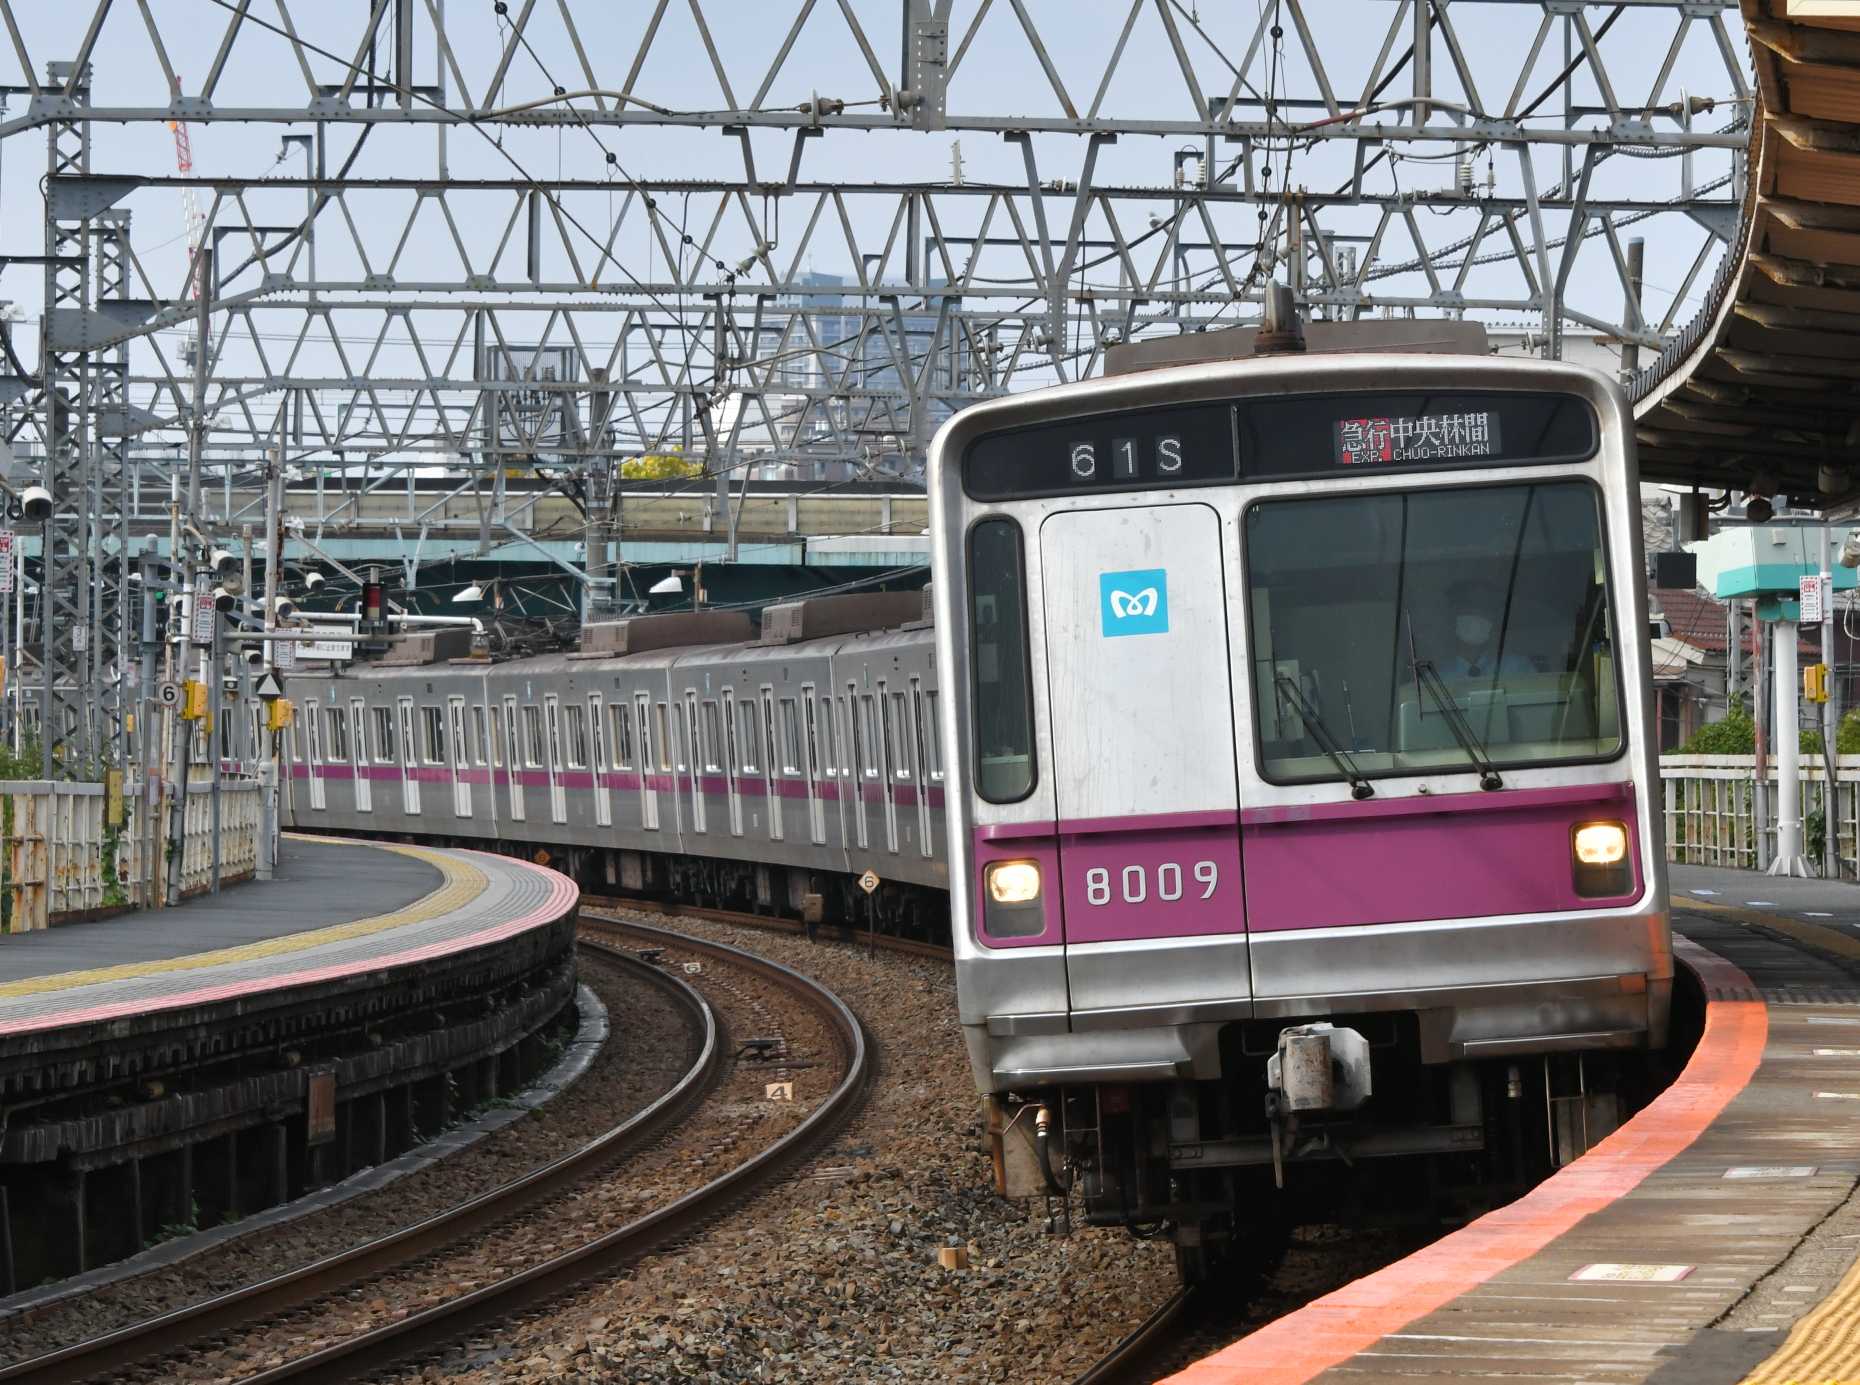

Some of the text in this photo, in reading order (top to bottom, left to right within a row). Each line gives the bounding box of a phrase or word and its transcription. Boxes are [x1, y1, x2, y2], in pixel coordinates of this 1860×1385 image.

[1351, 442, 1490, 464] EXP. CHUO-RINKAN
[163, 686, 175, 701] 6
[864, 876, 874, 888] 6
[1086, 861, 1219, 905] 8009
[771, 1085, 788, 1100] 4
